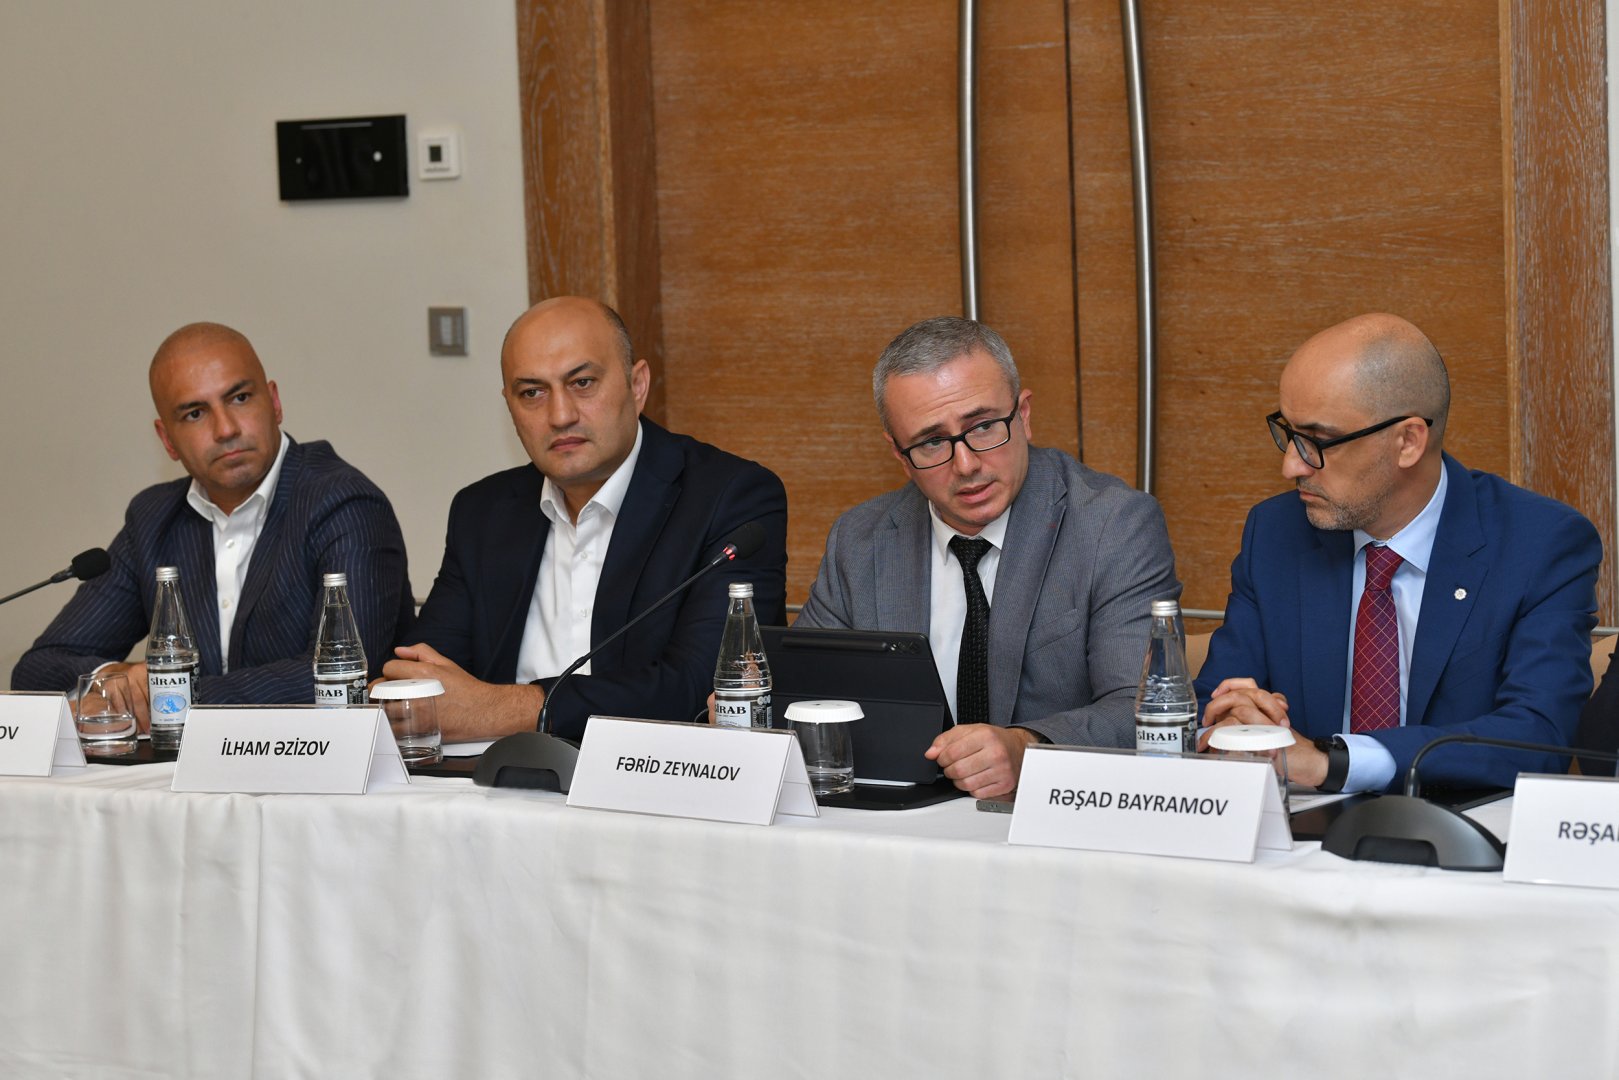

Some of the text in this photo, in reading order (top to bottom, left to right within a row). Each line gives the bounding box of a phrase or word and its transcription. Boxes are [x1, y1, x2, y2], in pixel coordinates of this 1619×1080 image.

[220, 737, 330, 756] İLHAM ƏZİZOV
[616, 755, 741, 781] FƏRİD ZEYNALOV
[1048, 788, 1229, 816] RƏŞAD BAYRAMOV
[1558, 821, 1619, 845] RƏŞA
